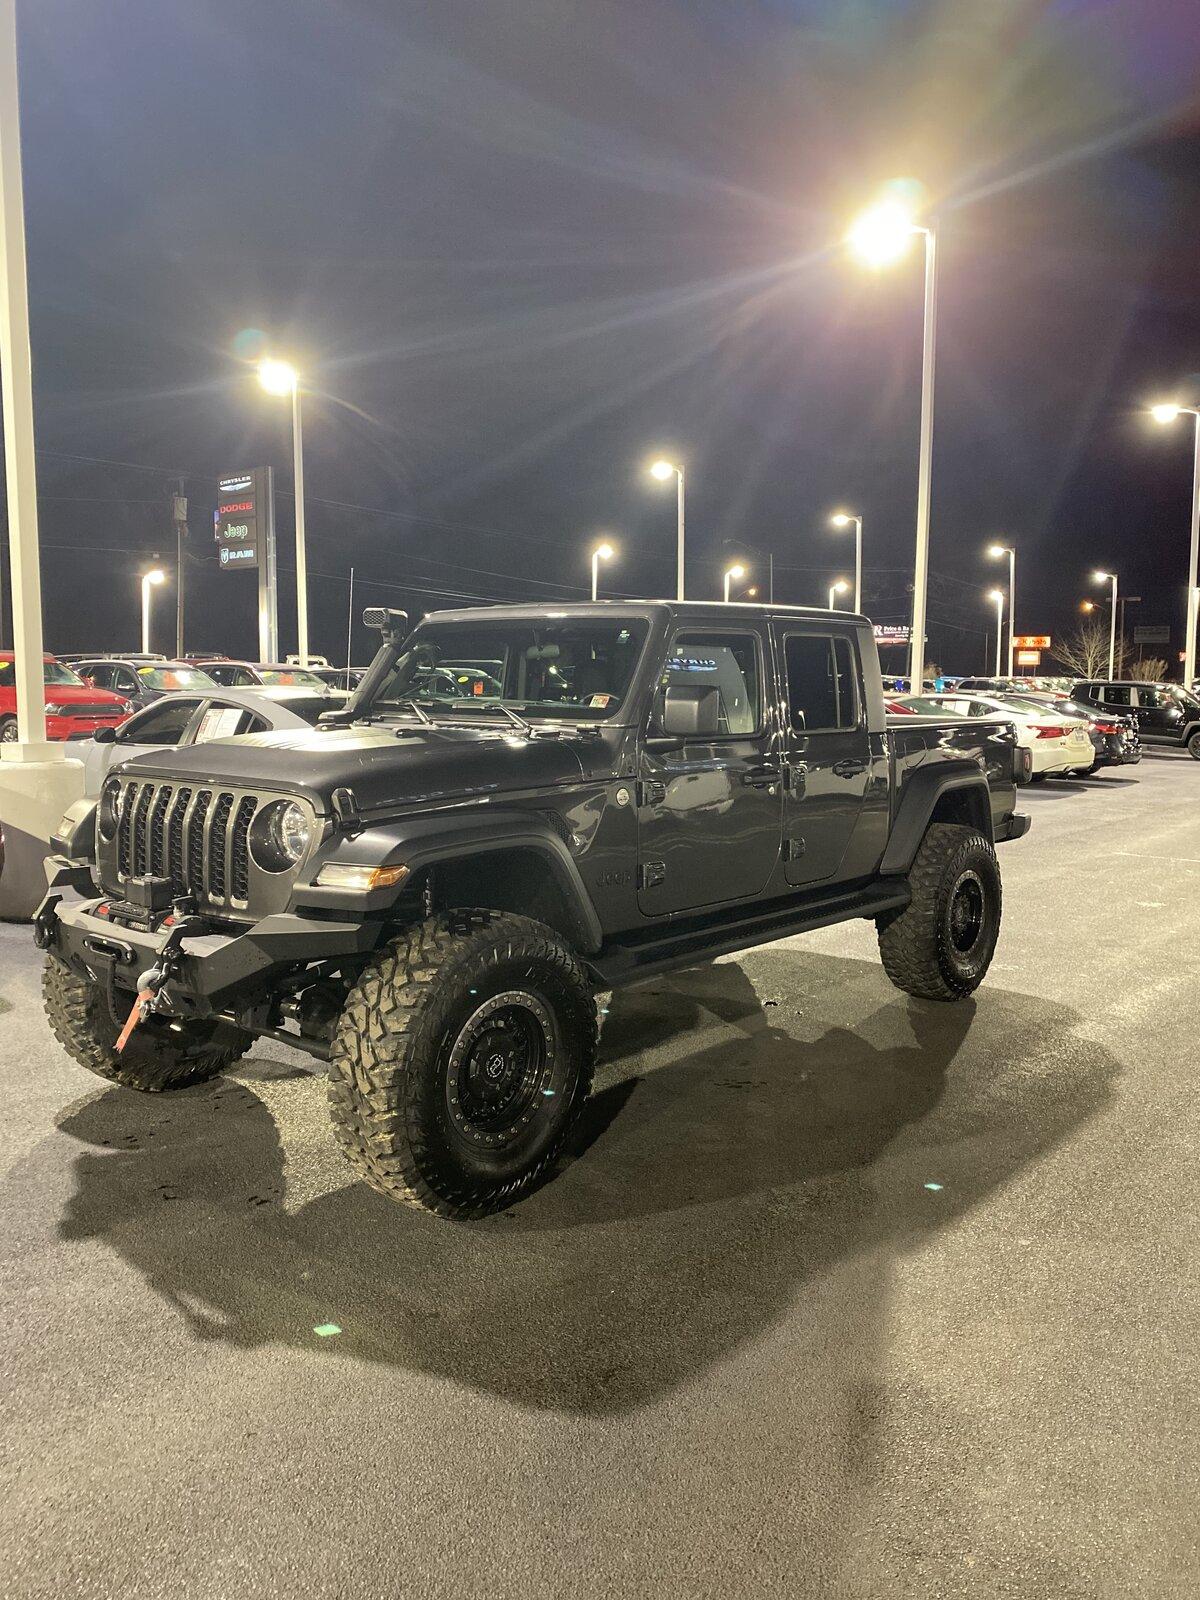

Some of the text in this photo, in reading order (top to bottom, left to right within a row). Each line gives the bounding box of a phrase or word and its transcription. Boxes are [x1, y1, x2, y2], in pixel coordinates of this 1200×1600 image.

[219, 476, 251, 486] CHRYSLER
[220, 502, 253, 514] DODGE
[223, 523, 248, 540] Jeep
[229, 549, 254, 560] RAM
